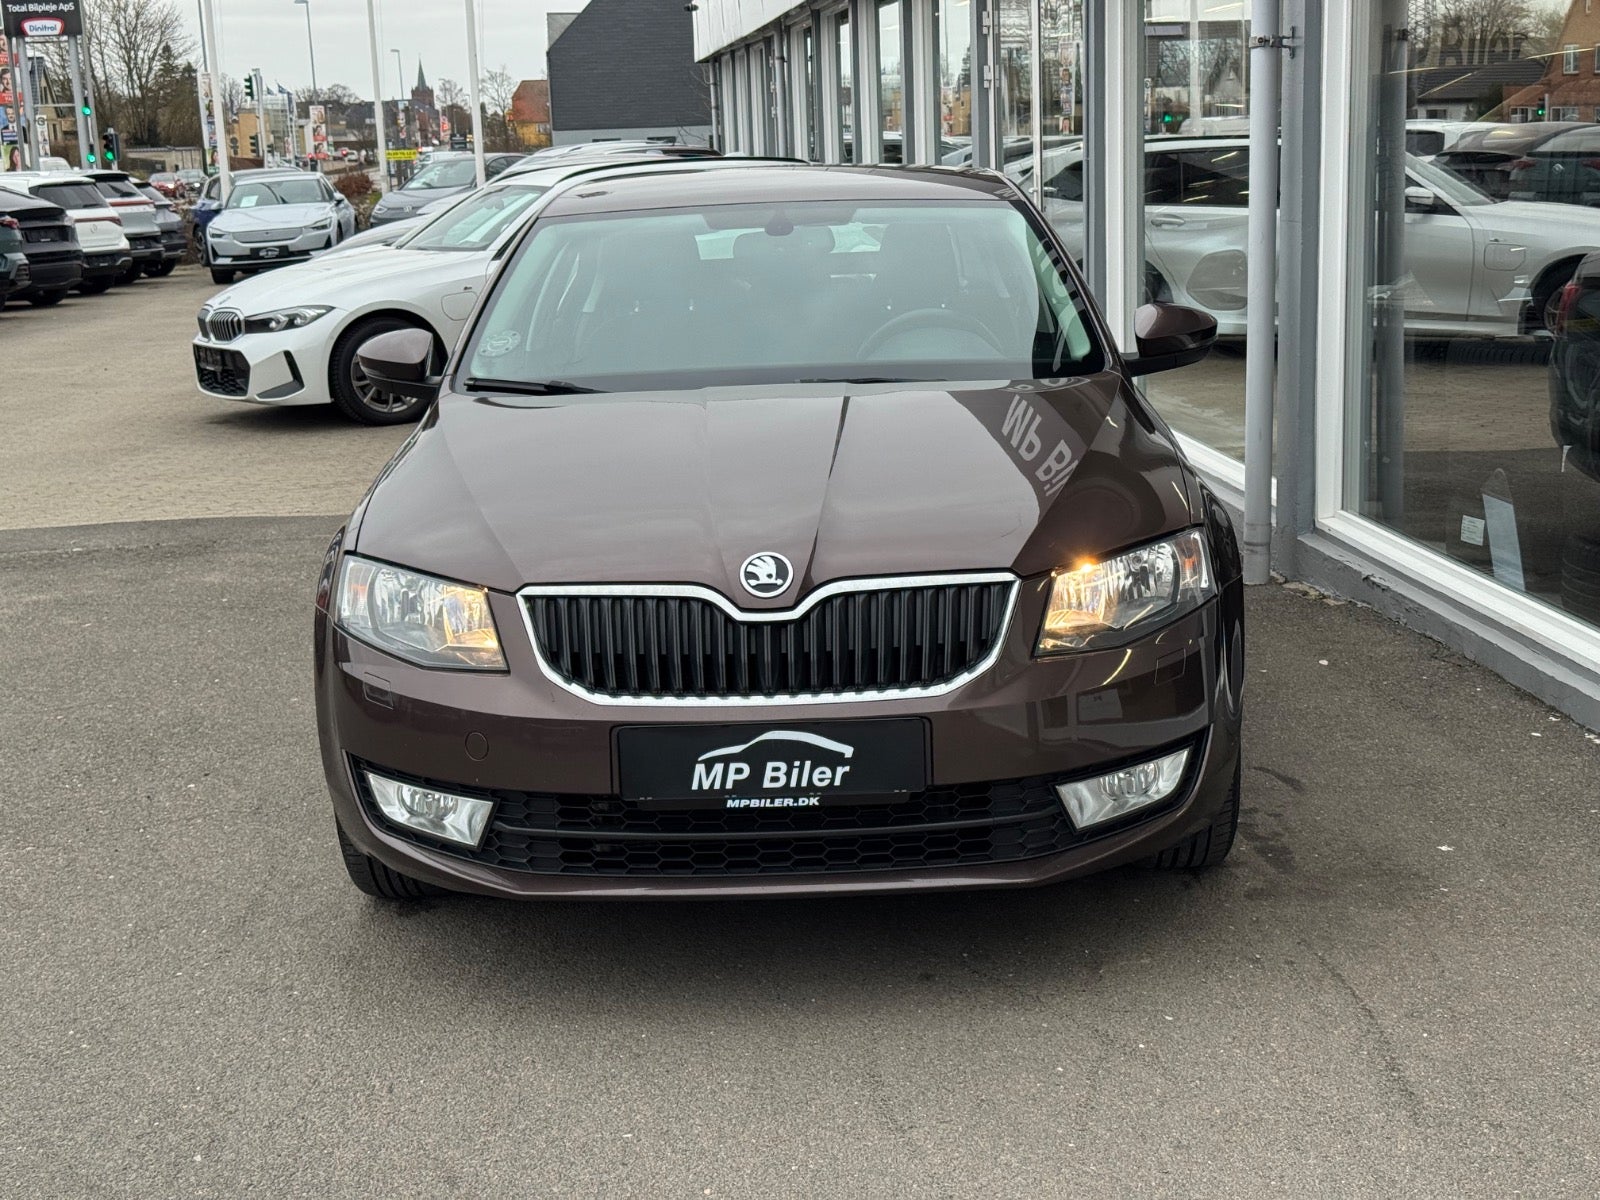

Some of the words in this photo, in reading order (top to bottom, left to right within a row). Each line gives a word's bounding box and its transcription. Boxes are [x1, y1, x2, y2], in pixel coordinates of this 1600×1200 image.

[6, 4, 28, 13] Total
[28, 3, 58, 13] Bilpleje
[58, 2, 75, 12] ApS
[28, 24, 57, 32] Dinitrol
[691, 762, 751, 790] MP
[762, 760, 850, 789] Biler
[726, 797, 820, 808] MPBILER.DK
